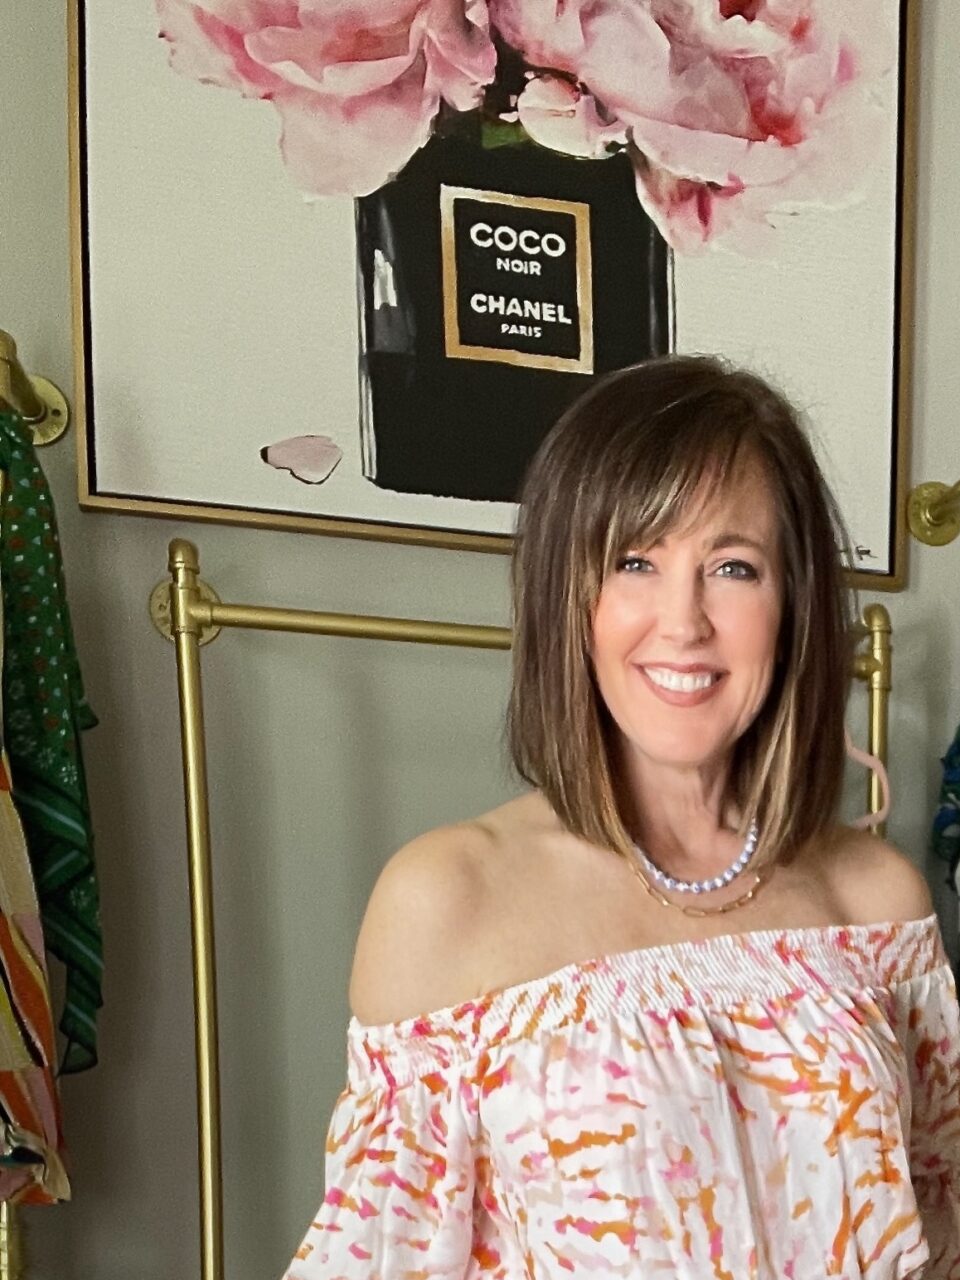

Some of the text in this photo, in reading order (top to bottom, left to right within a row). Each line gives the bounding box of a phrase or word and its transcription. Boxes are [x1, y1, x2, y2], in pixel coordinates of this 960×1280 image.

[469, 222, 567, 258] COCO
[496, 257, 543, 276] NOIR
[469, 293, 573, 325] CHANEL
[500, 323, 543, 338] PARIS
